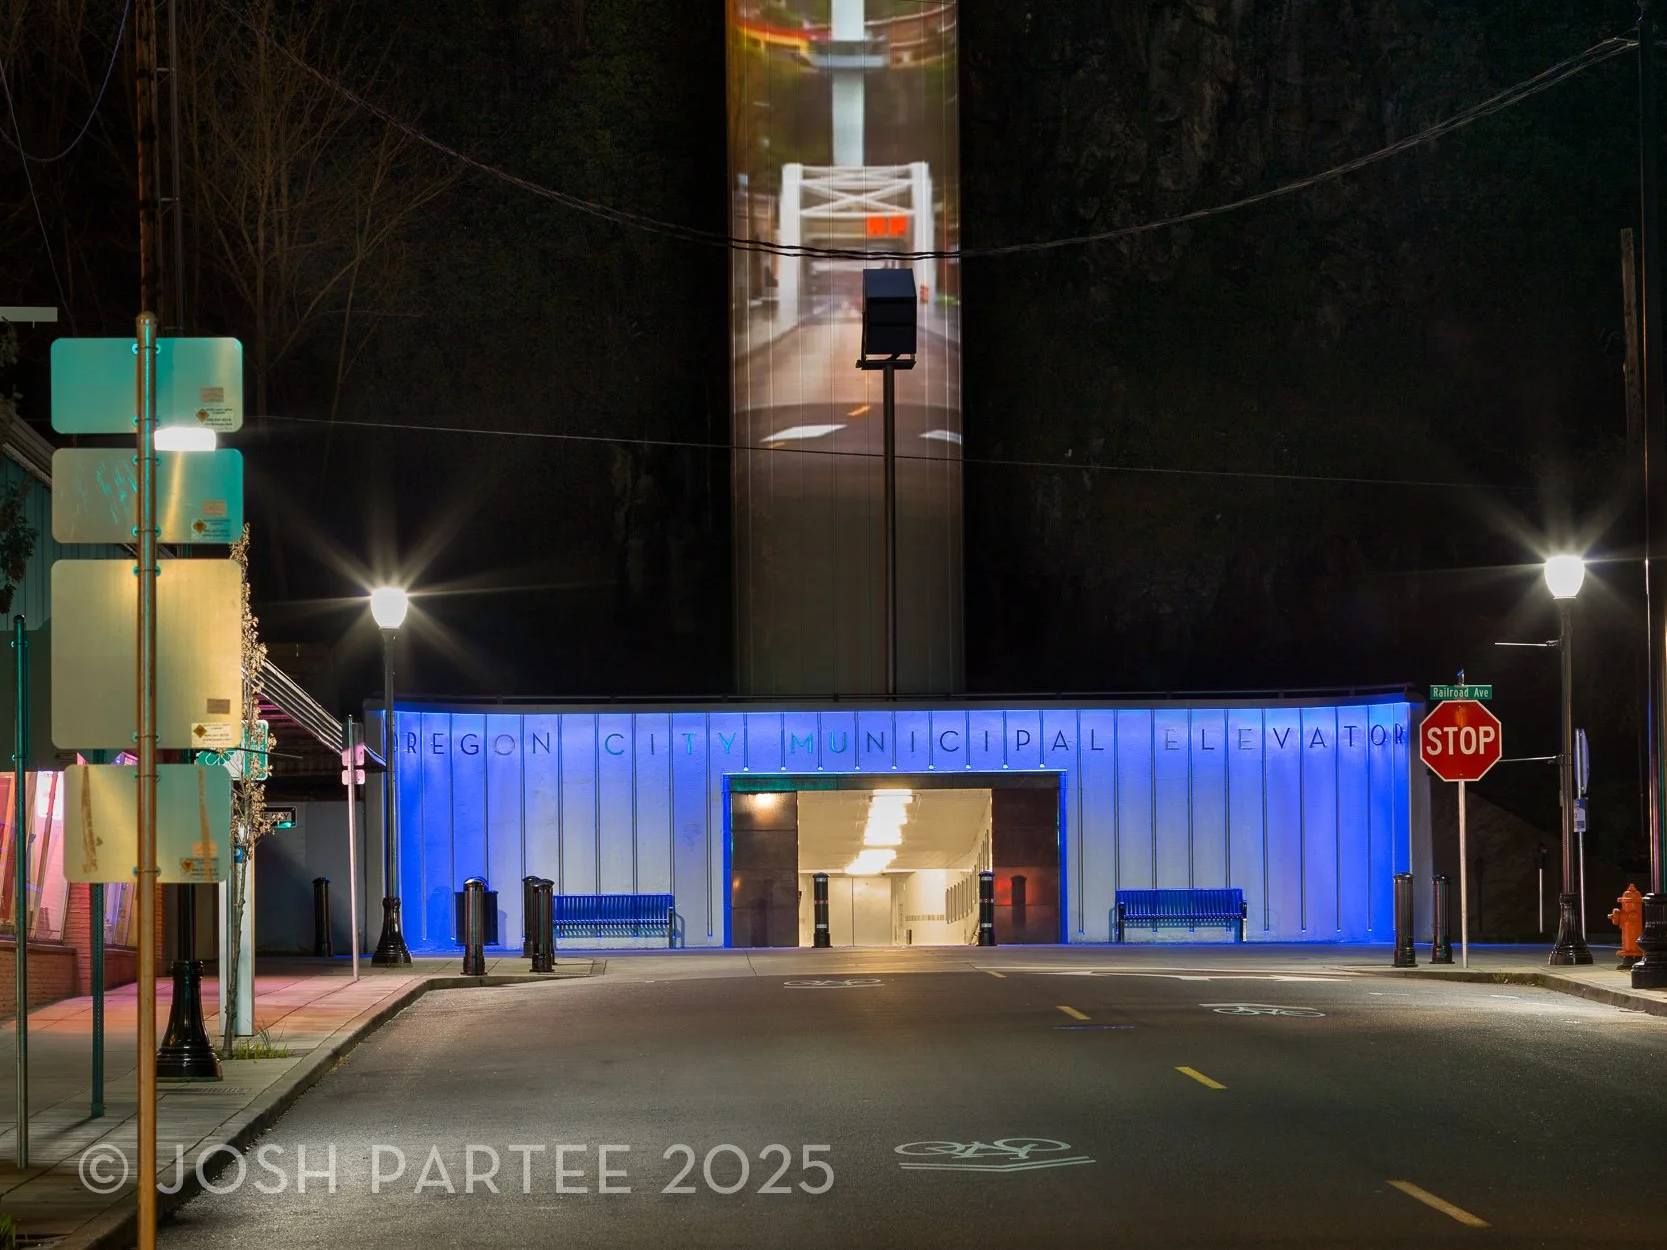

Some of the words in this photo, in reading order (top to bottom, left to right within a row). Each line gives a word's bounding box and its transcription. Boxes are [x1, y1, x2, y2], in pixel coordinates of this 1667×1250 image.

[1433, 687, 1469, 698] Railroad
[1474, 687, 1489, 698] Ave
[604, 732, 737, 756] CITY
[789, 730, 1105, 754] MUNICIPAL
[1164, 723, 1404, 751] ELEVATOR
[1426, 726, 1496, 756] STOP
